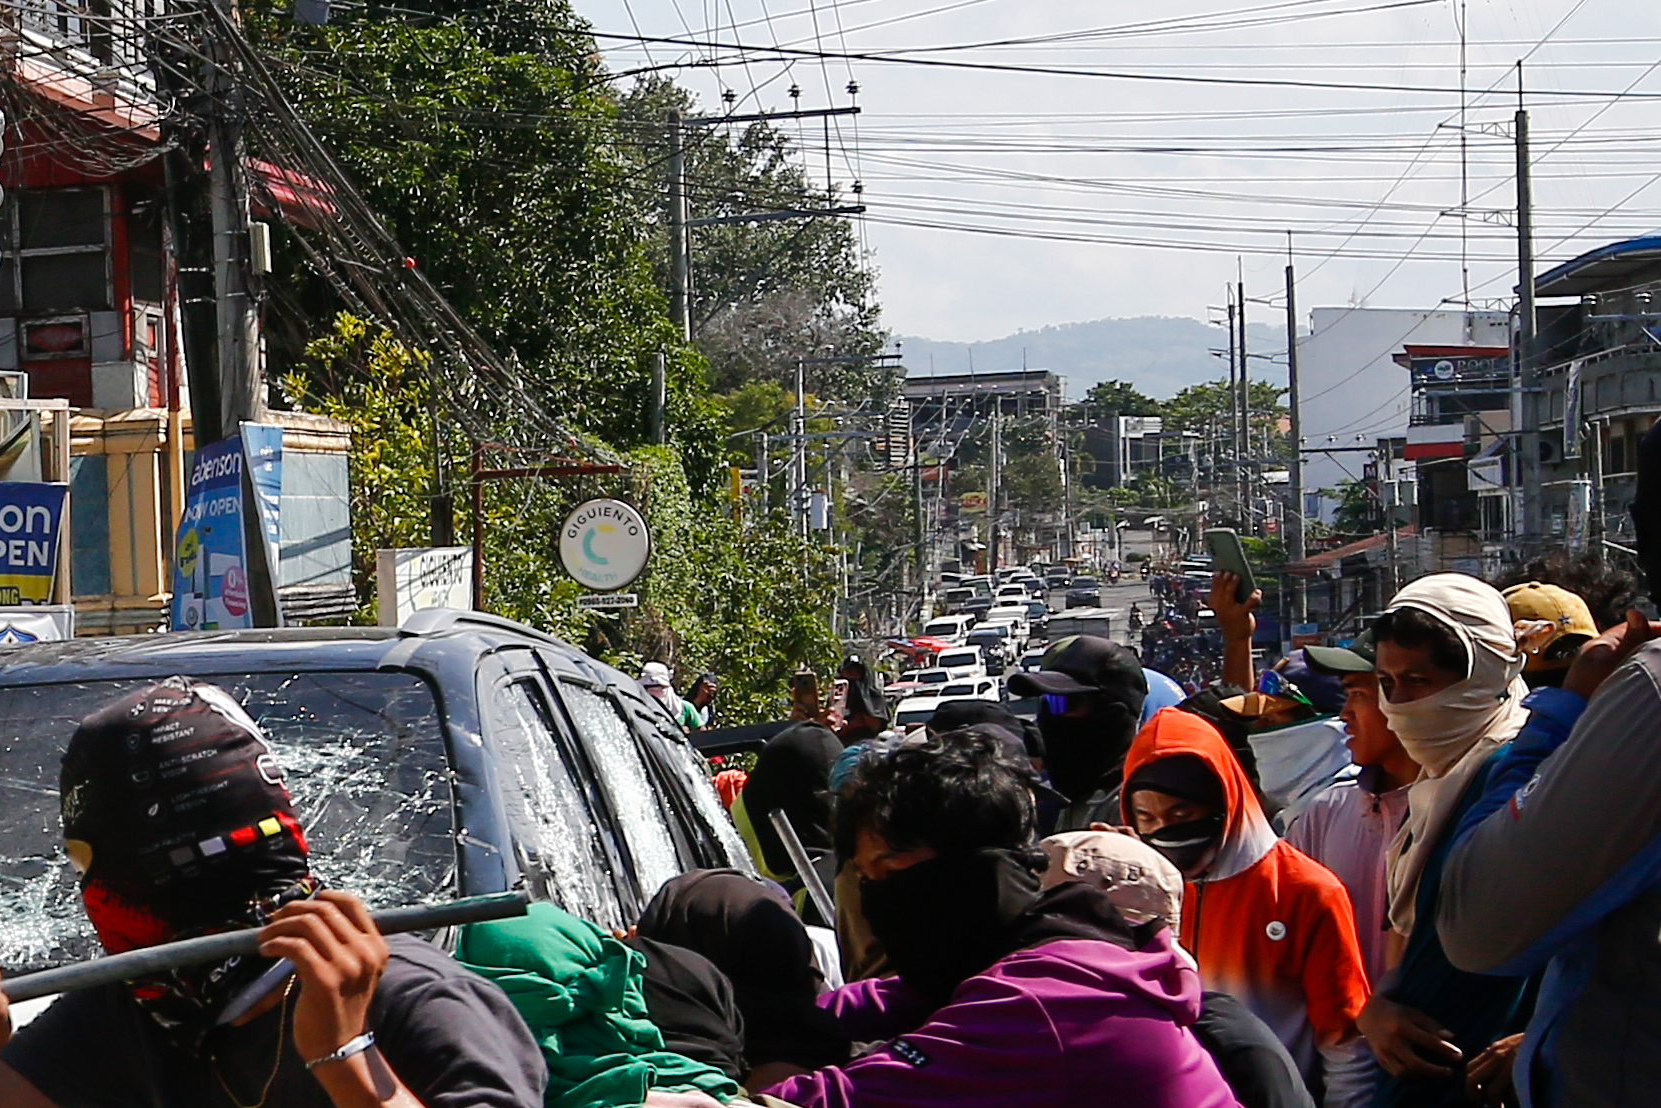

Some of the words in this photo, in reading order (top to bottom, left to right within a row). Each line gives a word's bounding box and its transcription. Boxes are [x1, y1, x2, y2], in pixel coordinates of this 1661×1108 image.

[191, 452, 241, 486] abenson
[210, 497, 240, 517] OPEN
[567, 507, 638, 539] GIGUIENTO
